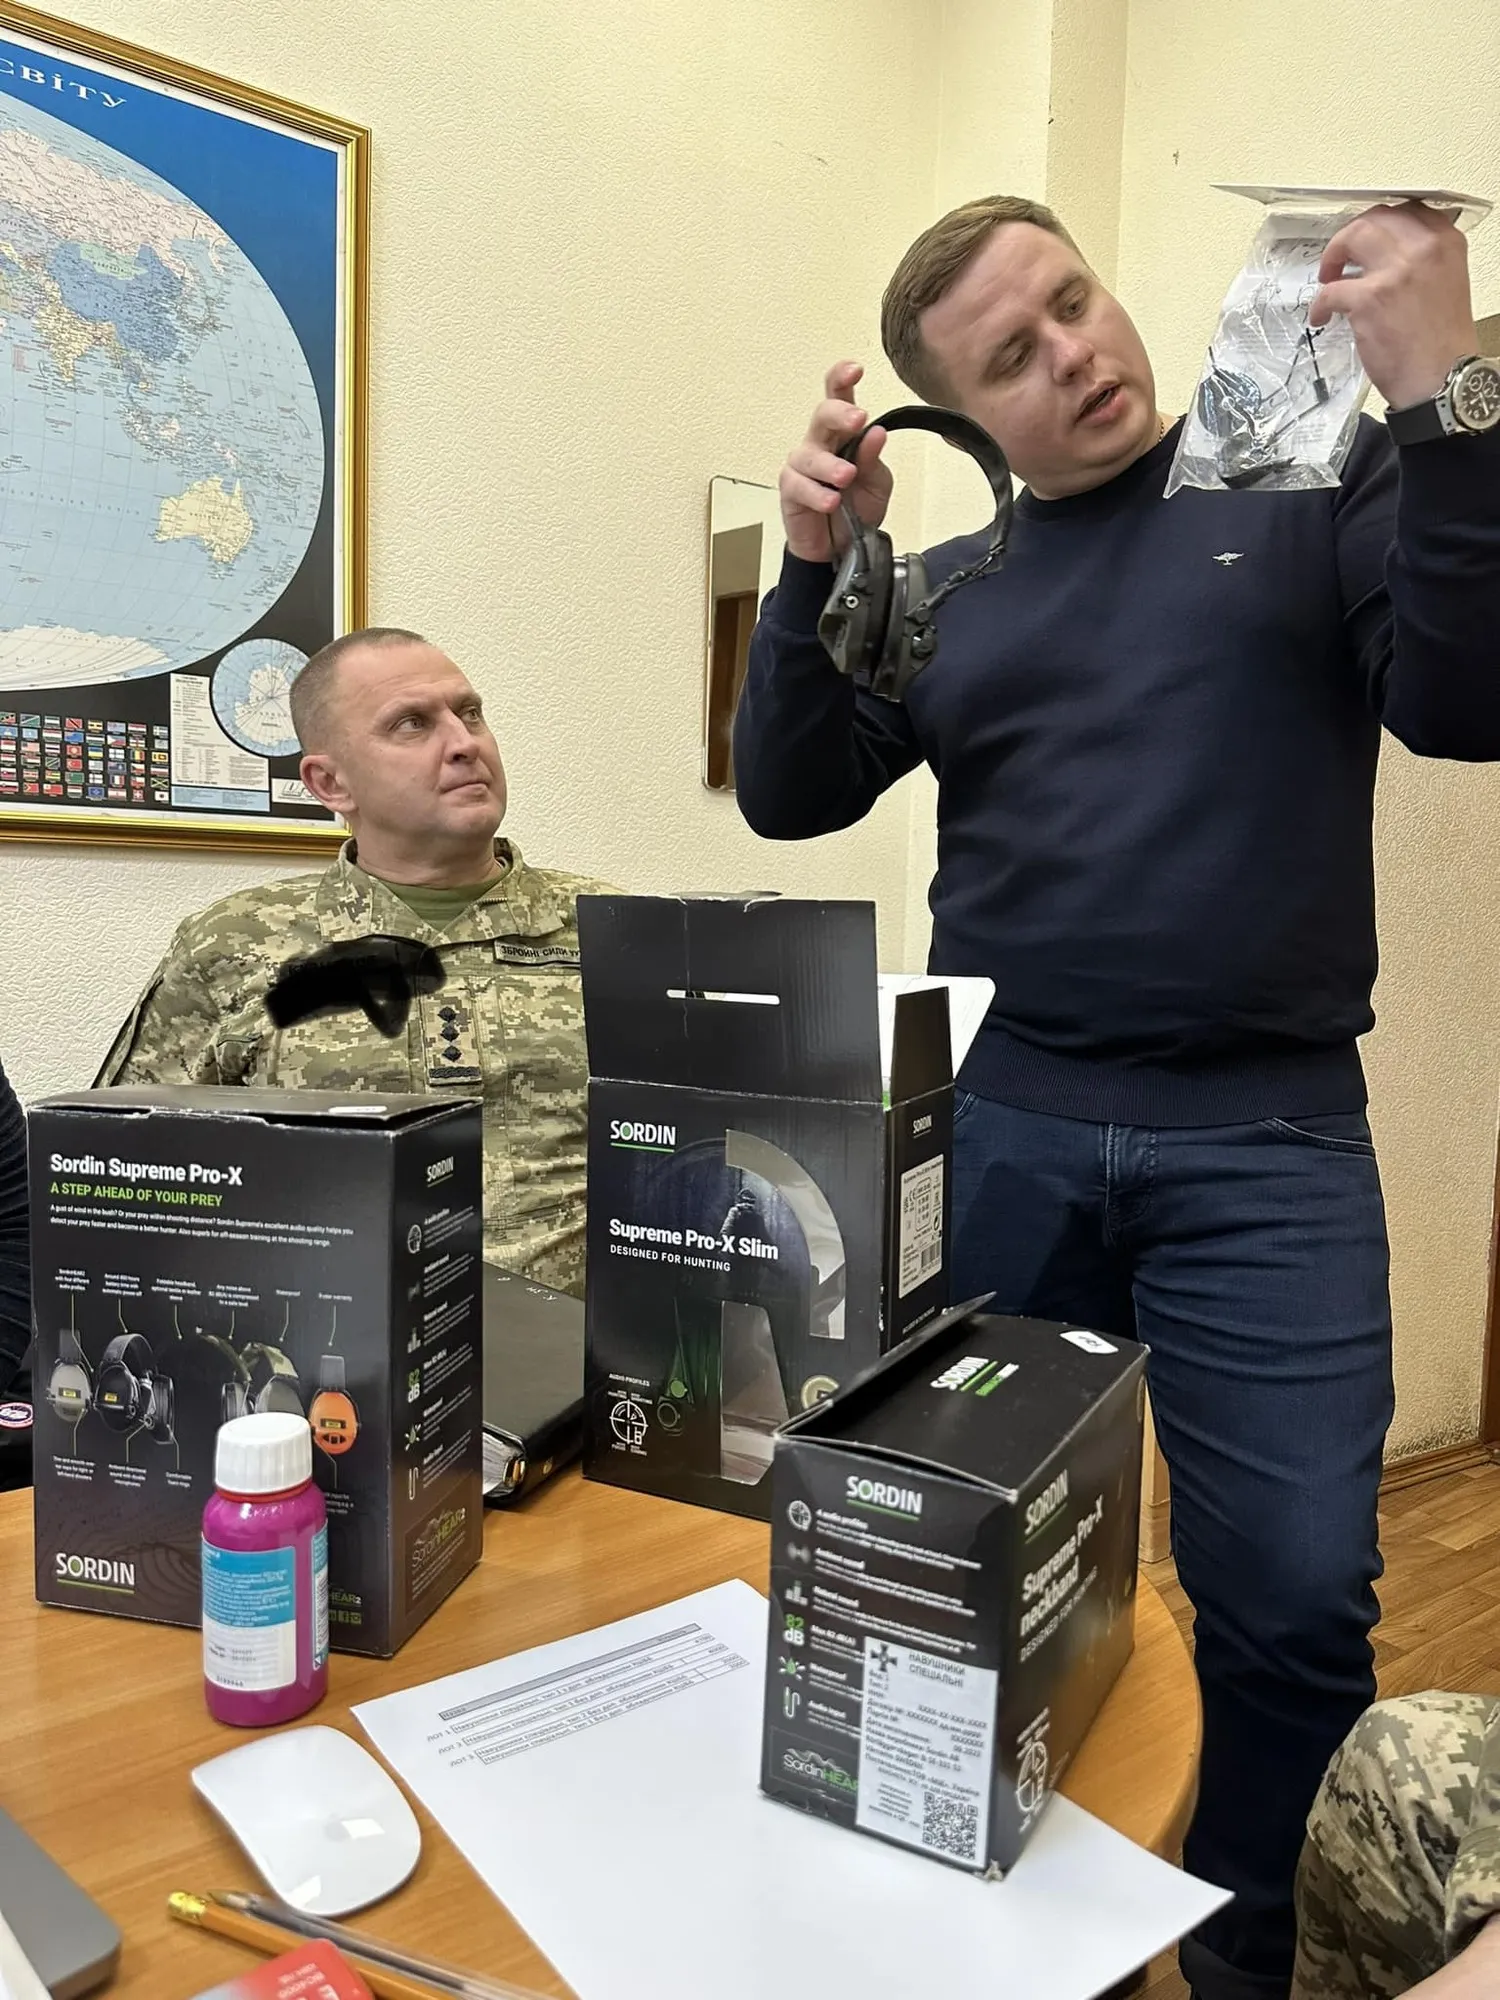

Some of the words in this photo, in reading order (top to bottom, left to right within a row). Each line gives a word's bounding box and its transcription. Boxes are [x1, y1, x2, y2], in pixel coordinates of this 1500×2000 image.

[542, 947, 568, 956] СИЛИ
[610, 1120, 676, 1146] SORDIN
[50, 1153, 105, 1176] Sordin
[109, 1157, 186, 1182] Supreme
[189, 1163, 243, 1186] Pro-X
[427, 1155, 454, 1182] SORDIN
[50, 1181, 59, 1194] A
[62, 1182, 91, 1196] STEP
[94, 1185, 134, 1200] AHEAD
[137, 1188, 152, 1201] OF
[155, 1190, 188, 1204] YOUR
[190, 1193, 223, 1207] PREY
[609, 1218, 682, 1246] Supreme
[686, 1229, 735, 1254] Pro-X
[738, 1237, 779, 1260] Slim
[610, 1244, 659, 1261] DESIGNED
[661, 1251, 681, 1264] FOR
[684, 1255, 731, 1272] HUNTING
[846, 1475, 923, 1515] SORDIN
[1024, 1469, 1068, 1536] SORDIN
[1023, 1534, 1077, 1602] Supreme
[1077, 1494, 1103, 1547] Pro-X
[56, 1552, 135, 1586] SORDIN
[1020, 1554, 1079, 1637] neckband
[783, 1627, 805, 1646] dB
[908, 1652, 966, 1676] НАВУШНИКИ
